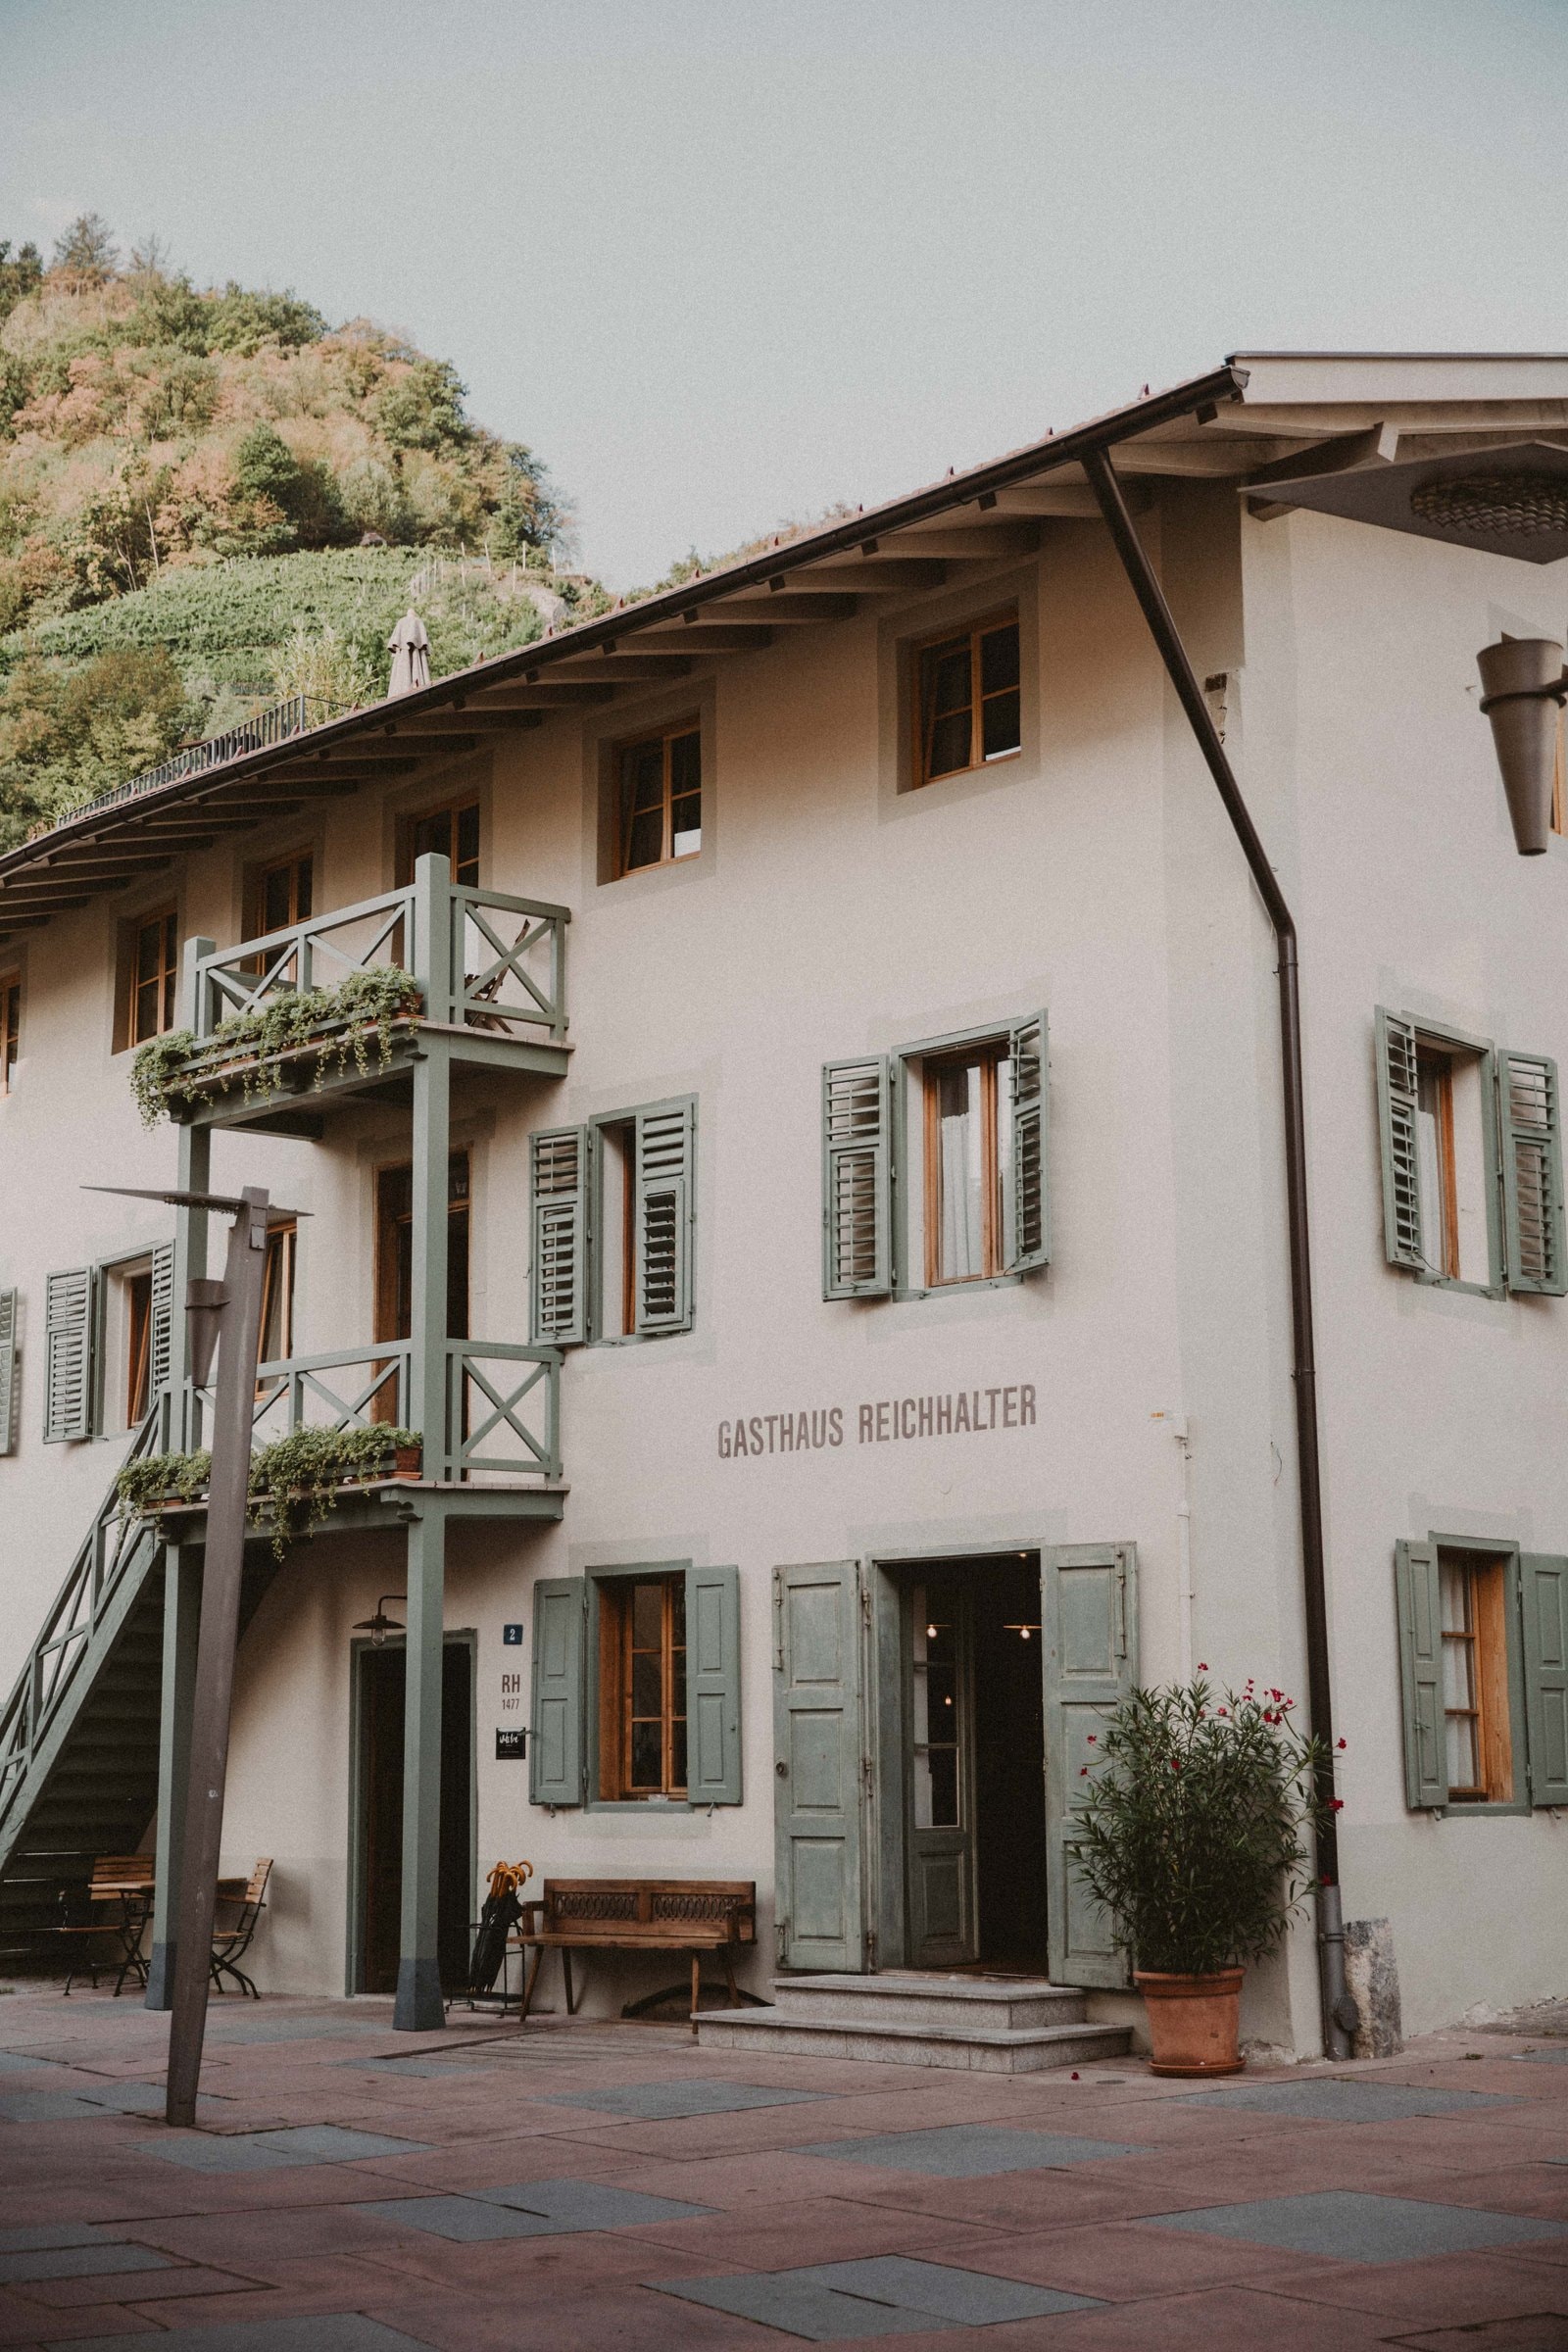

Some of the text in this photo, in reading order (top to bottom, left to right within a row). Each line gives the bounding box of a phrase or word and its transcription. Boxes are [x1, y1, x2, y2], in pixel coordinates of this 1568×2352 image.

[718, 1384, 1037, 1459] GASTHAUS REICHHALTER
[510, 1628, 515, 1641] 2
[502, 1674, 520, 1693] RH
[502, 1698, 519, 1710] 1477
